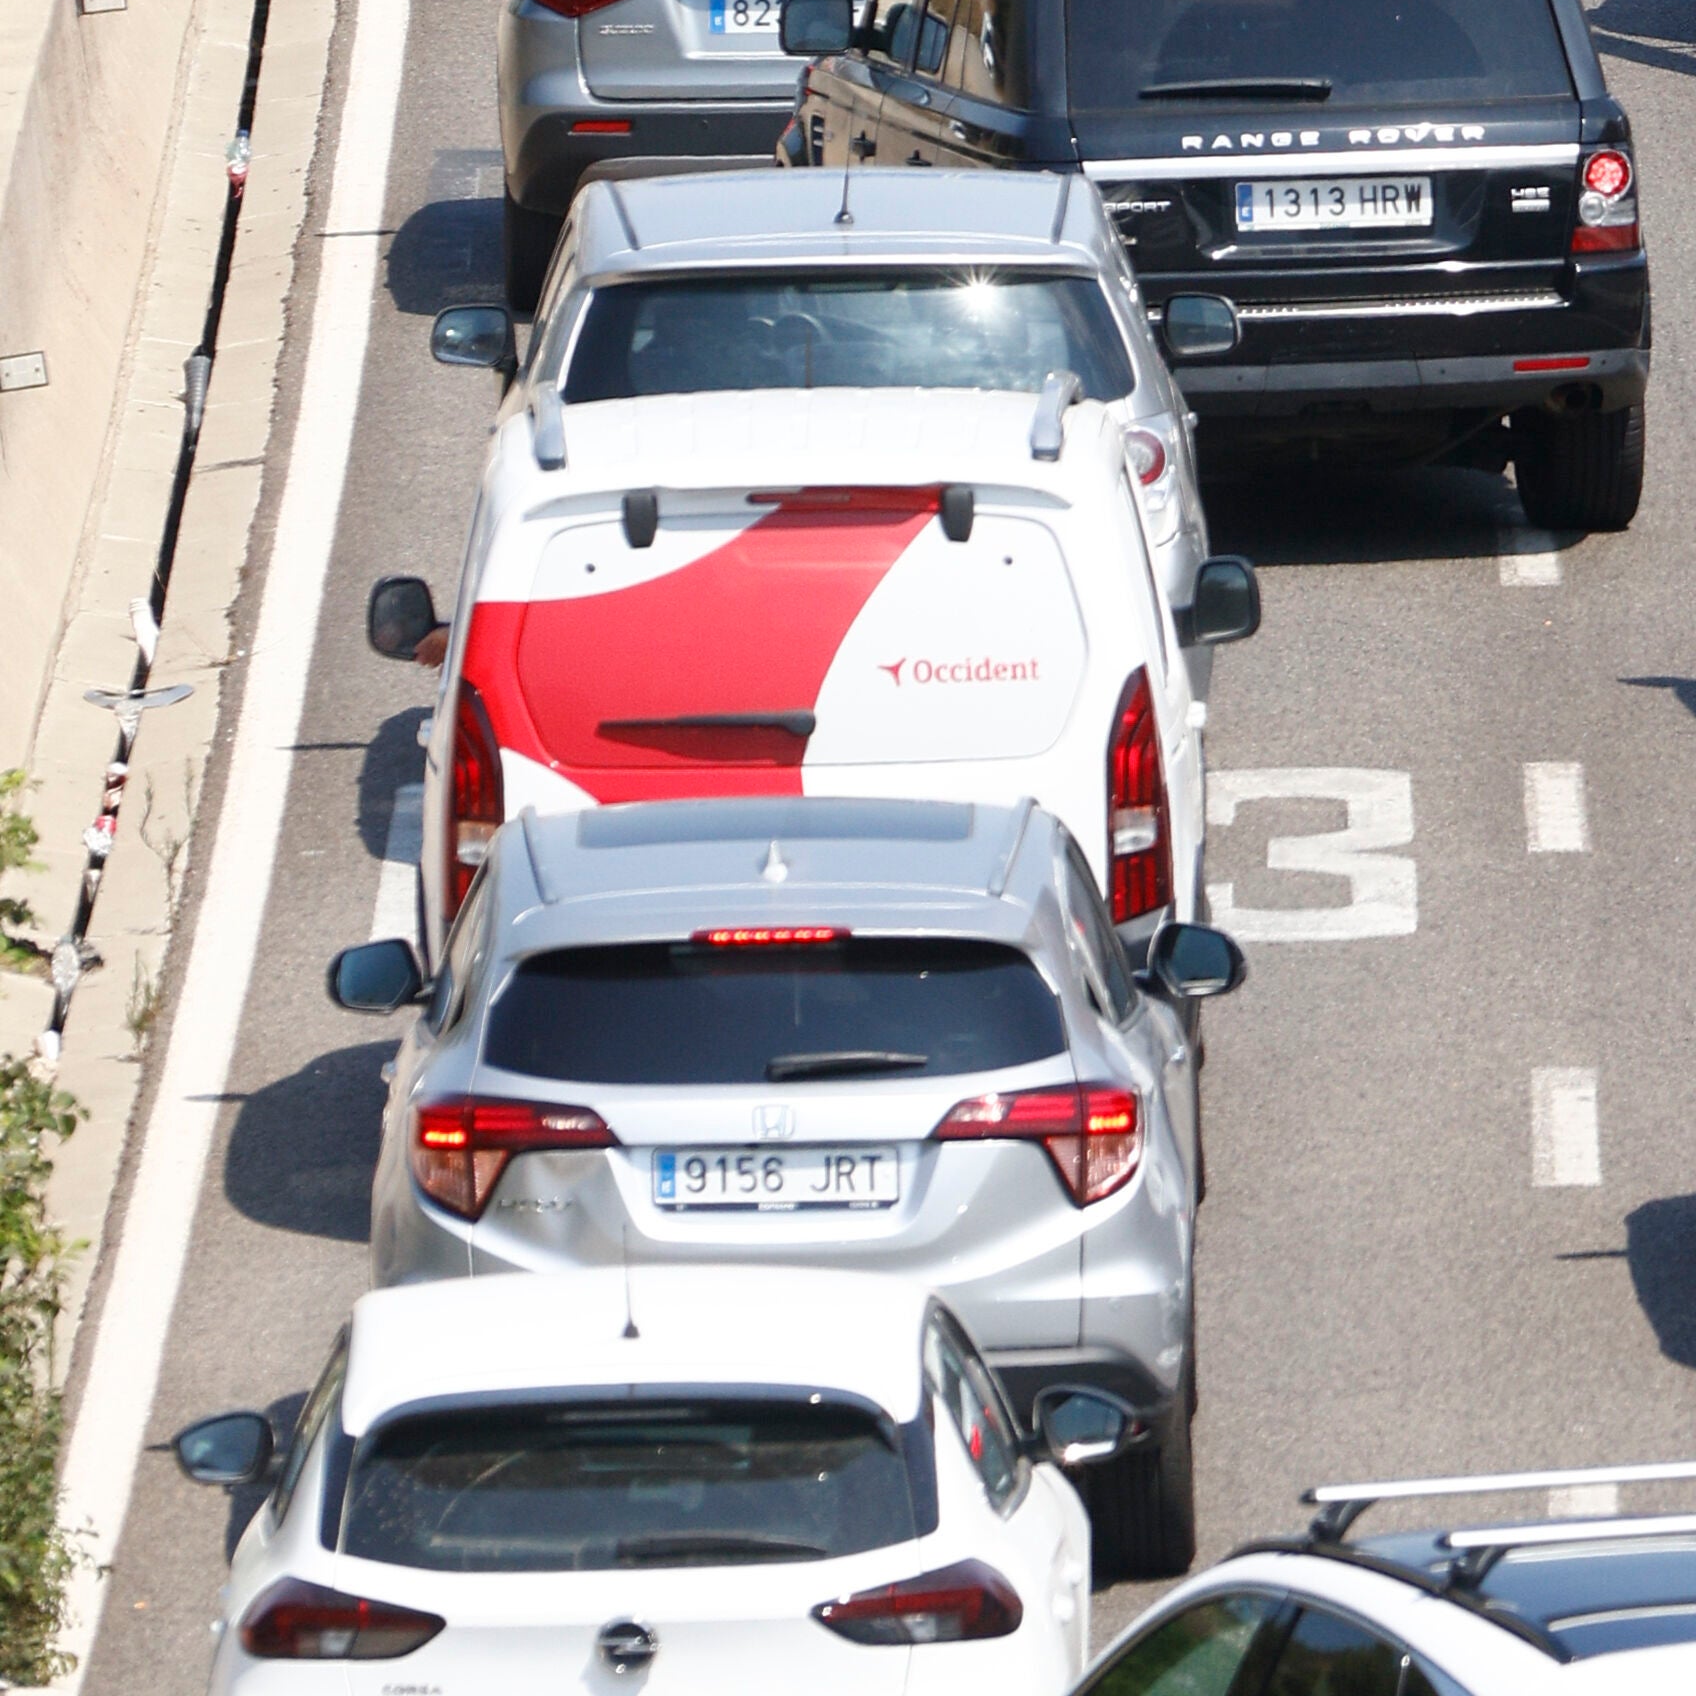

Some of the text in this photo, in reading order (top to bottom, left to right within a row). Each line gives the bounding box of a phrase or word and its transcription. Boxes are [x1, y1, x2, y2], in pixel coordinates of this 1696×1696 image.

[1180, 124, 1485, 150] RANGE ROVER
[1102, 200, 1172, 213] SPORT
[1264, 184, 1345, 219] 1313
[1359, 183, 1422, 216] HRW
[912, 656, 1040, 684] Occident
[685, 1155, 785, 1194] 9156
[809, 1155, 884, 1193] JRT
